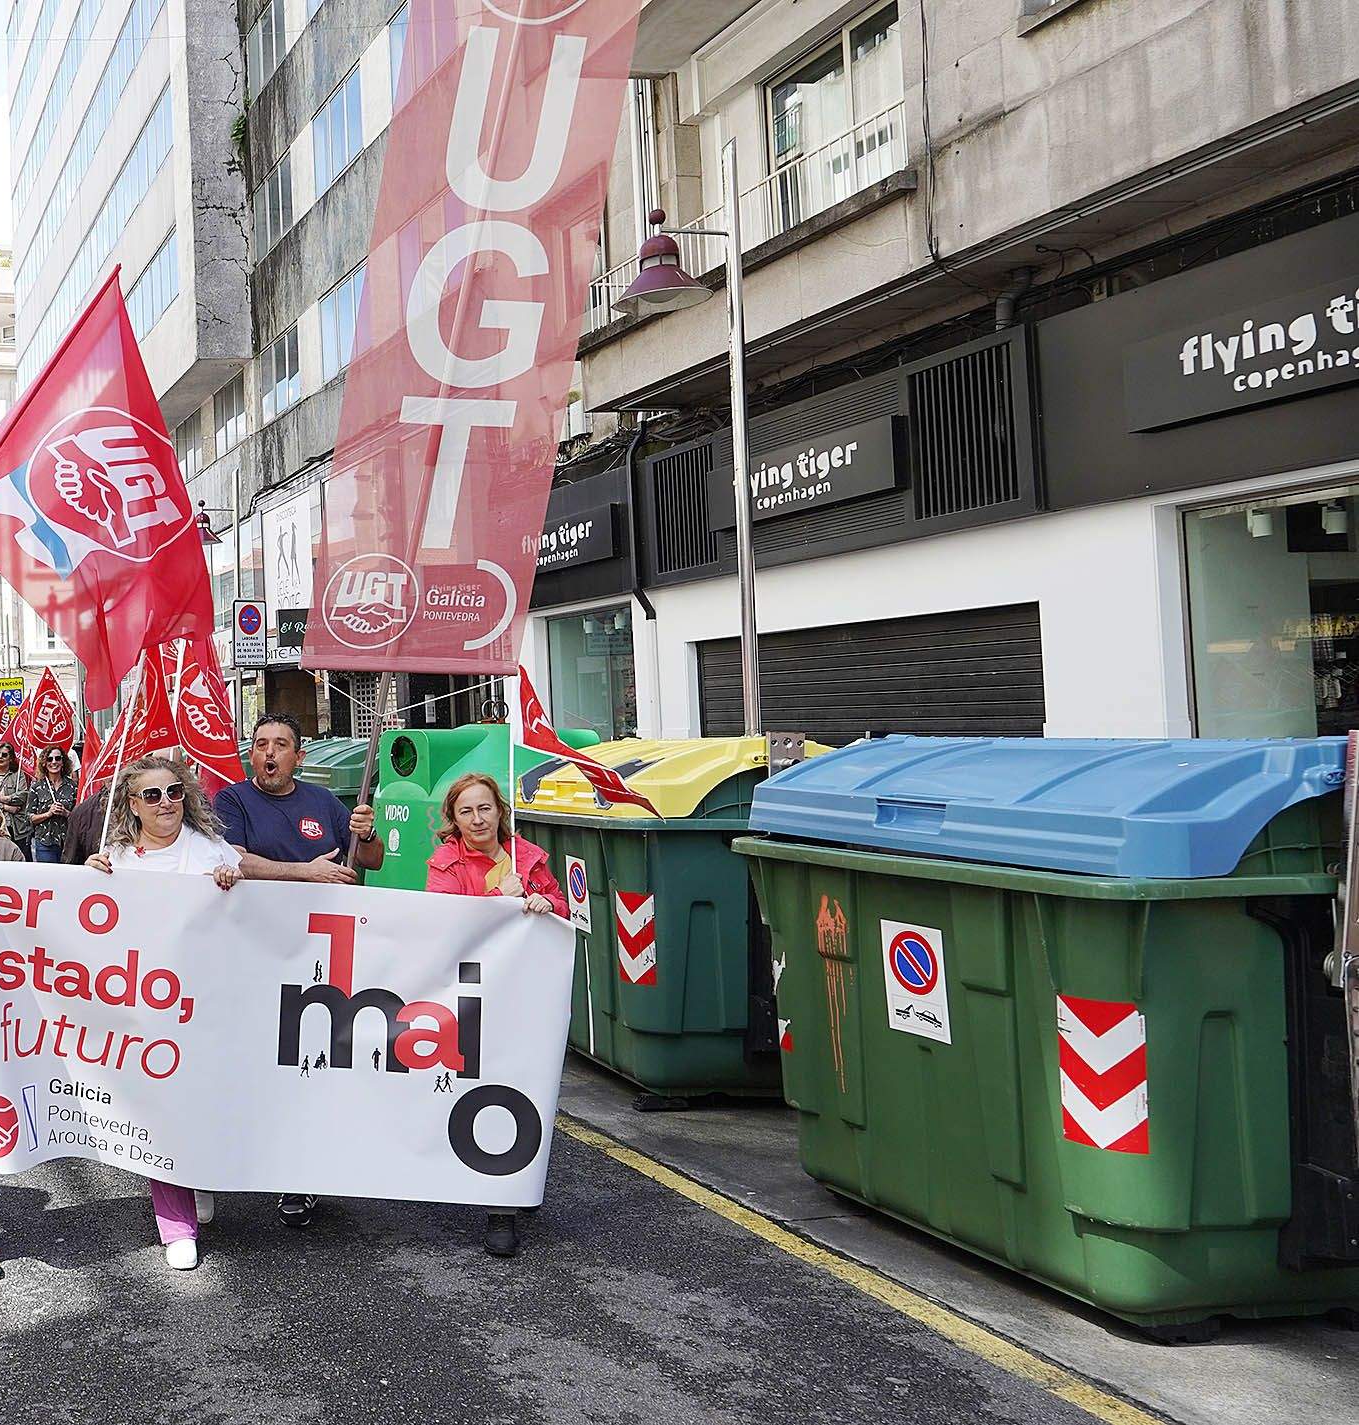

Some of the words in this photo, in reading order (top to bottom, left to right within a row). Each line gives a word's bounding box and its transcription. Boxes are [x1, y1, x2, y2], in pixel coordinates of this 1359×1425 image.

[399, 25, 588, 549] UGT
[1179, 313, 1318, 376] flying
[75, 425, 184, 533] UGT
[749, 461, 794, 498] ying
[796, 441, 858, 480] tiger
[756, 480, 832, 510] copenhagen
[521, 530, 558, 556] flying
[557, 520, 593, 547] tiger
[535, 548, 579, 567] copenhagen
[337, 571, 408, 610] UGT
[426, 588, 486, 608] Galicia
[280, 621, 293, 634] El
[422, 610, 481, 622] PONTEVEDRA
[33, 694, 59, 734] UGT
[385, 804, 410, 822] VIDRO
[78, 892, 120, 936] o
[0, 1001, 181, 1081] futuro
[48, 1078, 113, 1105] Galicia
[47, 1104, 153, 1145] Pontevedra,
[47, 1128, 108, 1151] Arousa
[113, 1142, 124, 1156] e
[129, 1144, 175, 1171] Deza
